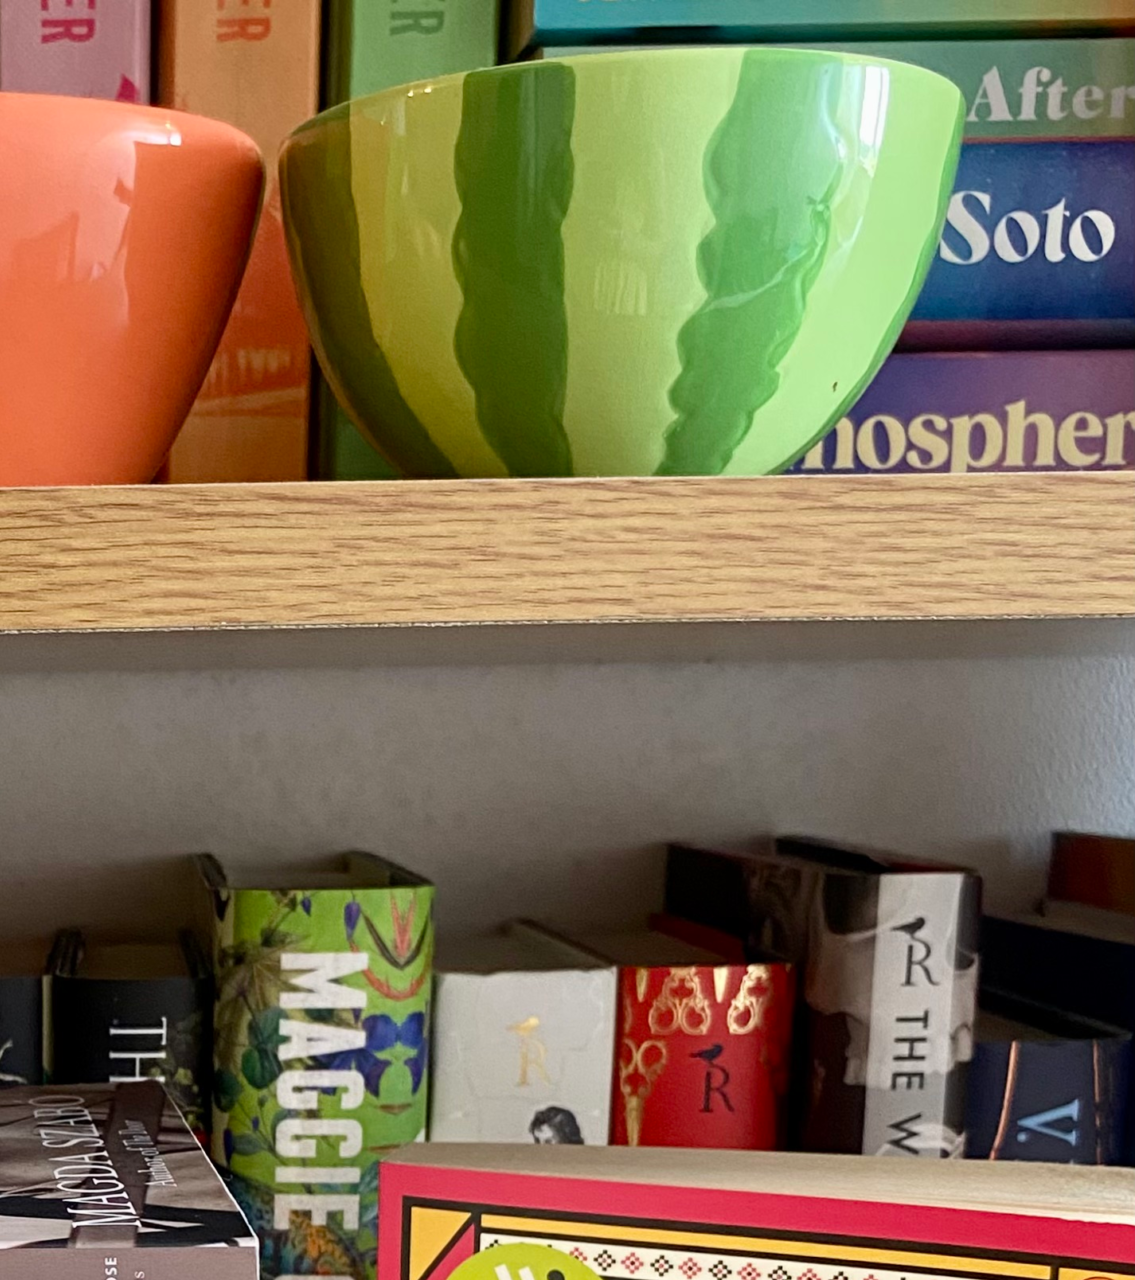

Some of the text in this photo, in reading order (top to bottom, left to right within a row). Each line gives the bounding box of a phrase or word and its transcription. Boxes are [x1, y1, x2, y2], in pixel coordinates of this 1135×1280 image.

[966, 65, 1135, 121] After
[938, 190, 1116, 265] Soto
[891, 1010, 929, 1090] THE
[274, 952, 368, 1232] MAGGIE
[49, 1150, 142, 1228] MAGDA
[125, 1146, 160, 1157] of
[137, 1156, 177, 1188] Author
